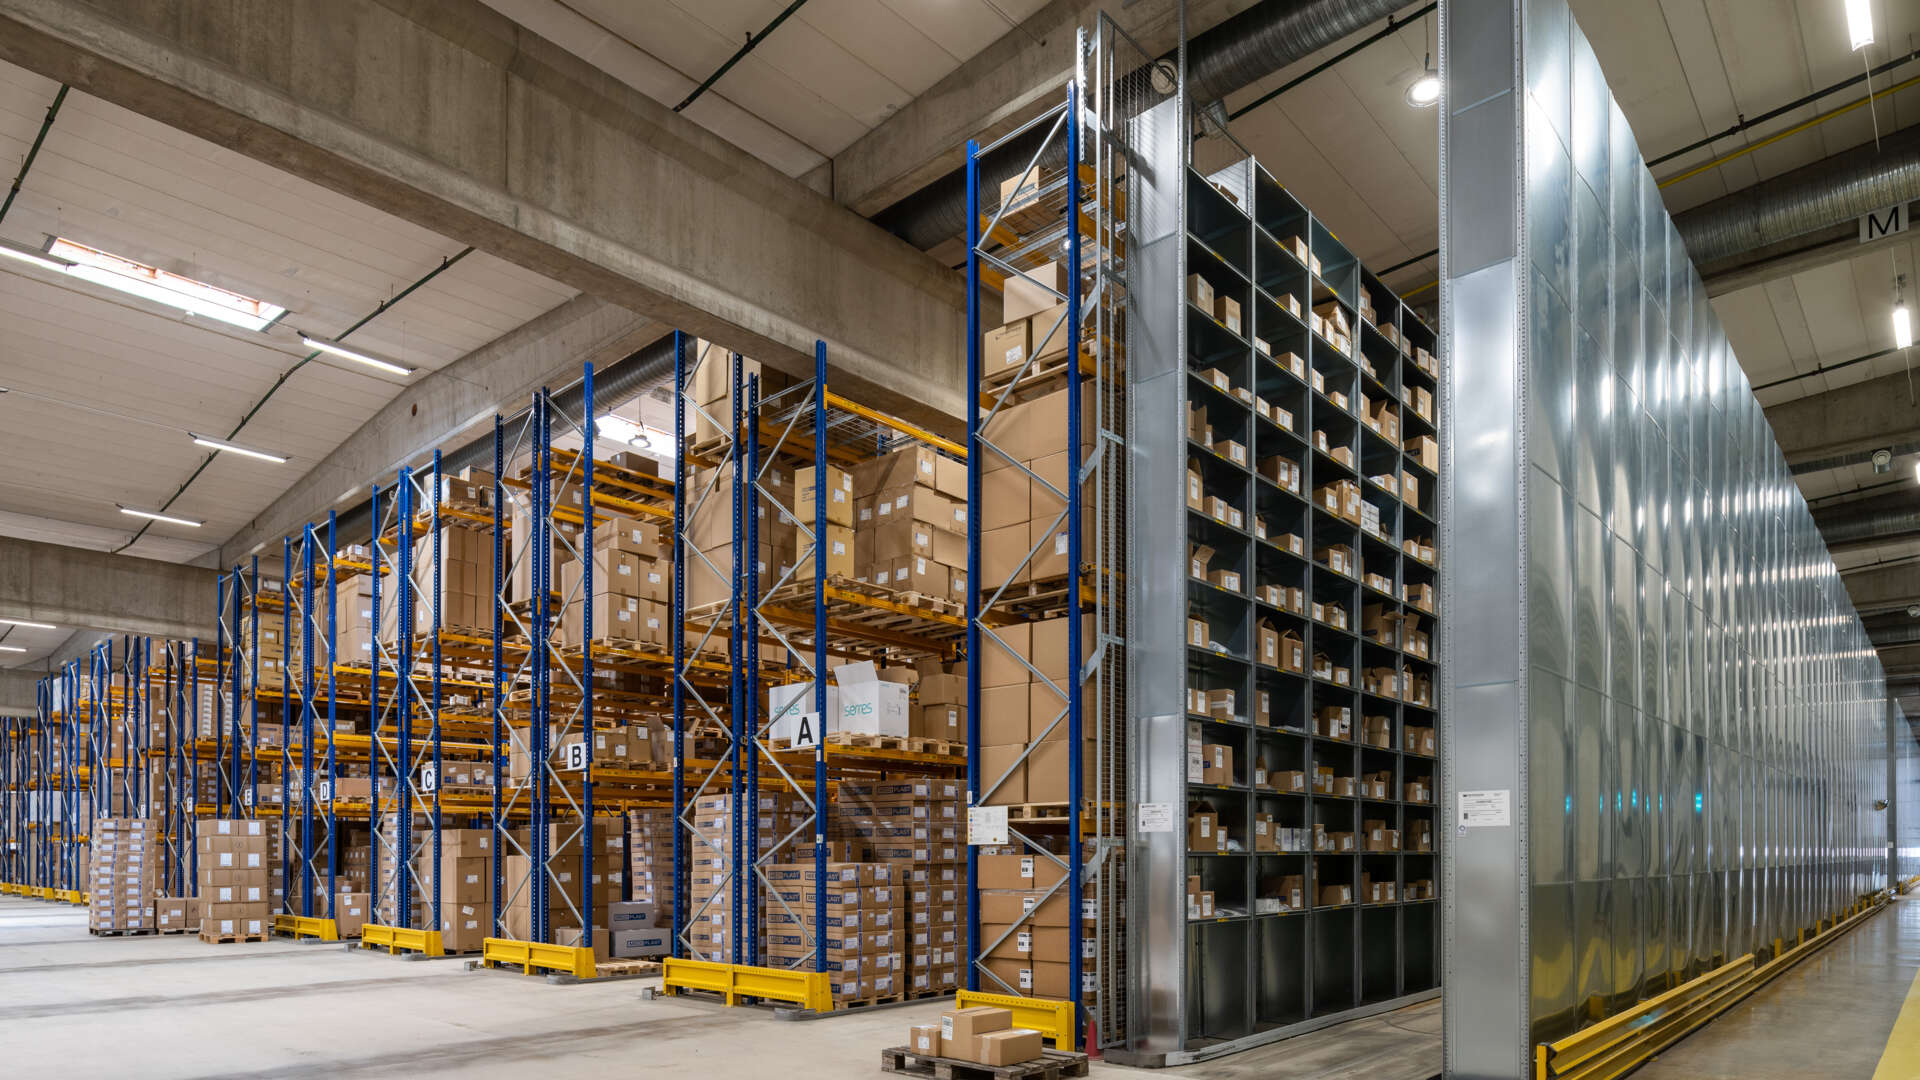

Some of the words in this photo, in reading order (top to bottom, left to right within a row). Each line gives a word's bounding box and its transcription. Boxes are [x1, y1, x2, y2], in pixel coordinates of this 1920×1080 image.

[1868, 206, 1899, 240] M
[797, 716, 814, 745] A
[572, 745, 582, 768] B
[322, 783, 328, 799] D
[425, 770, 433, 789] C
